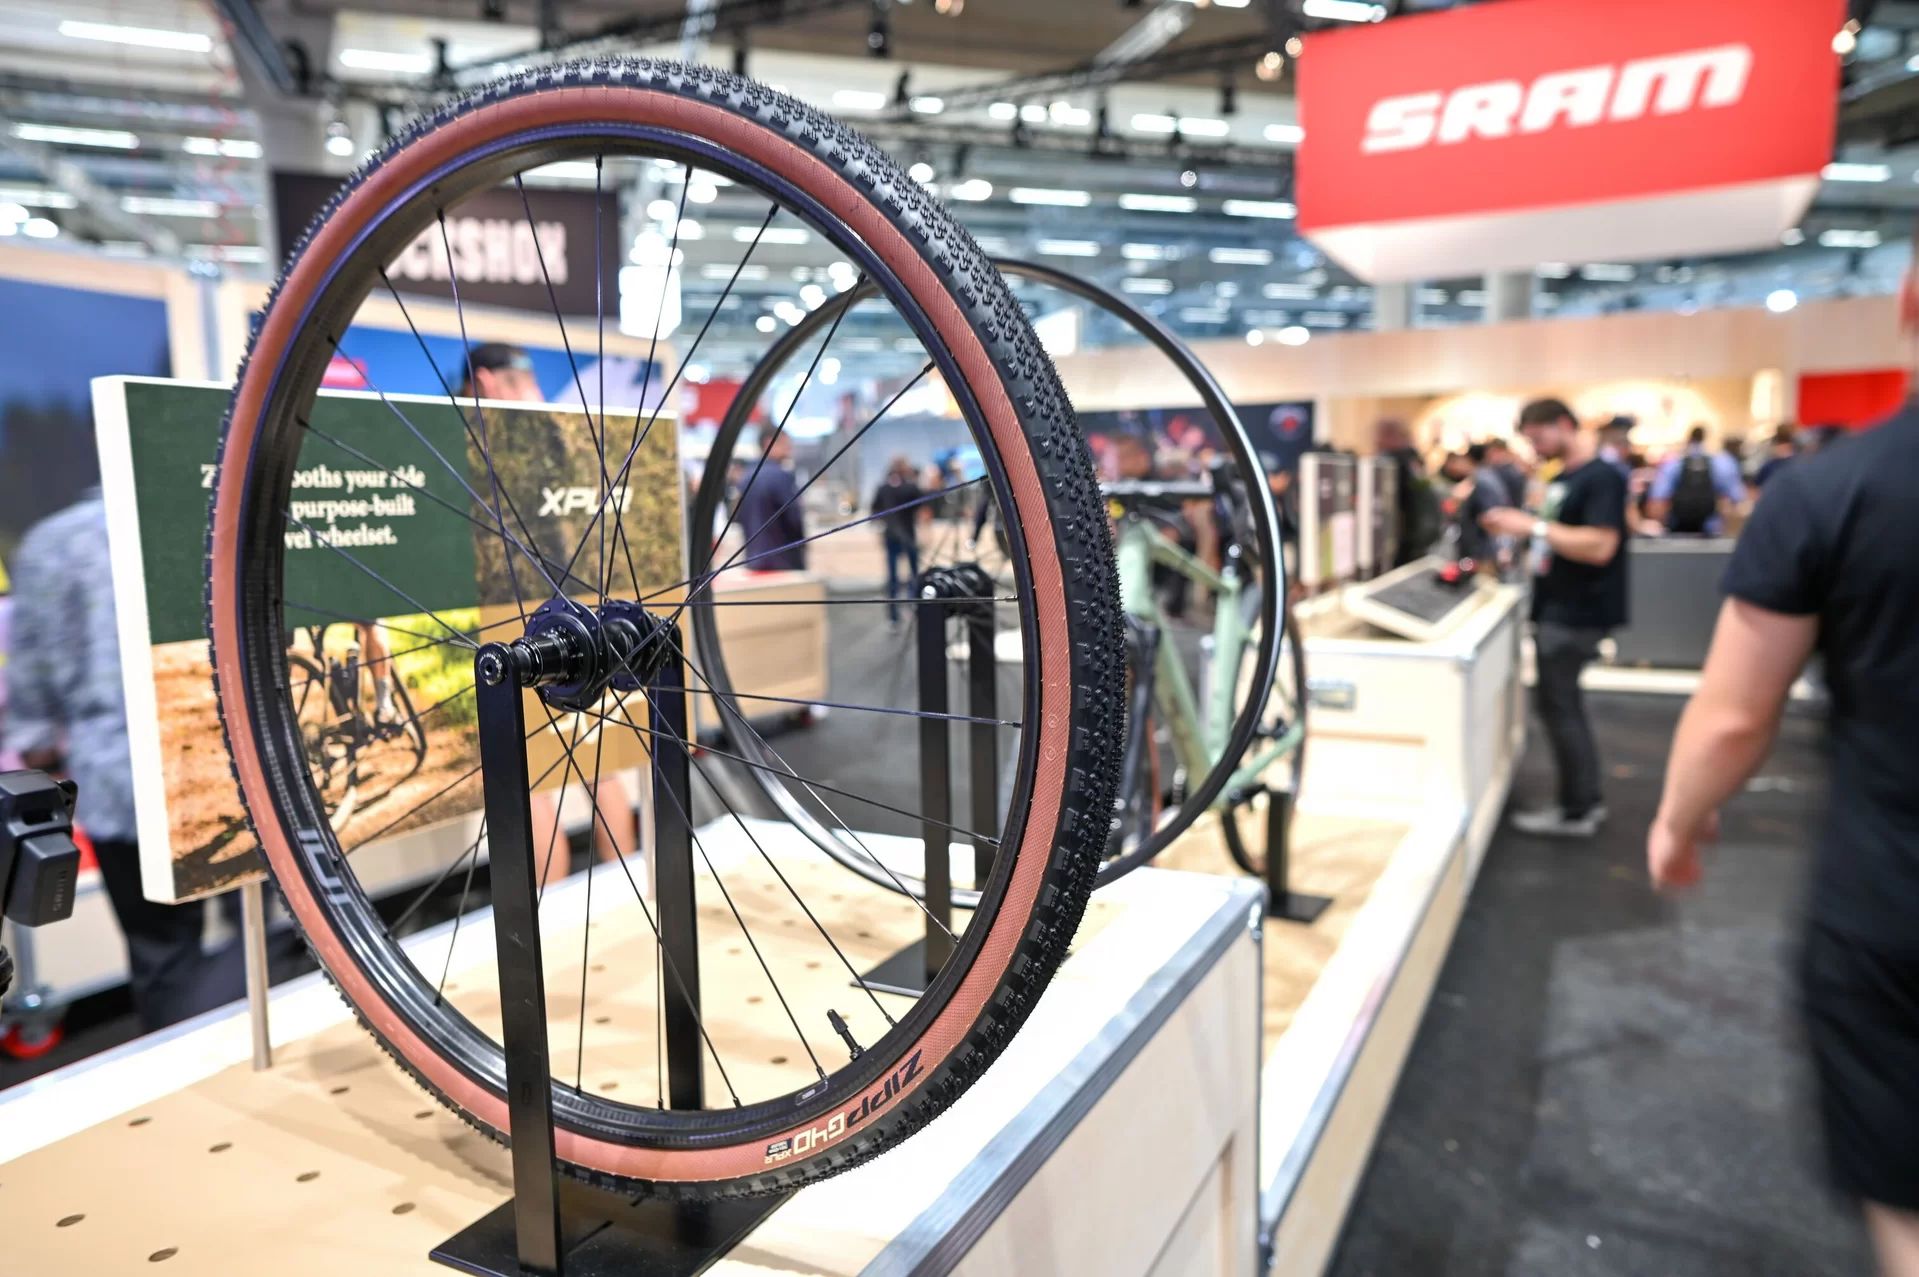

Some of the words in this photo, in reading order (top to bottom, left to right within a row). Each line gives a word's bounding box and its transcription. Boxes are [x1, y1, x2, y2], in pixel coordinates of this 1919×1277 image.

[1362, 43, 1752, 153] SRAM
[385, 217, 567, 284] CKSHOX
[345, 469, 387, 493] your
[390, 464, 426, 488] ride
[291, 493, 416, 523] purpose-built
[284, 526, 313, 549] vel
[317, 523, 397, 548] wheelset.
[847, 1049, 924, 1128] ZIPP
[793, 1112, 845, 1155] G40
